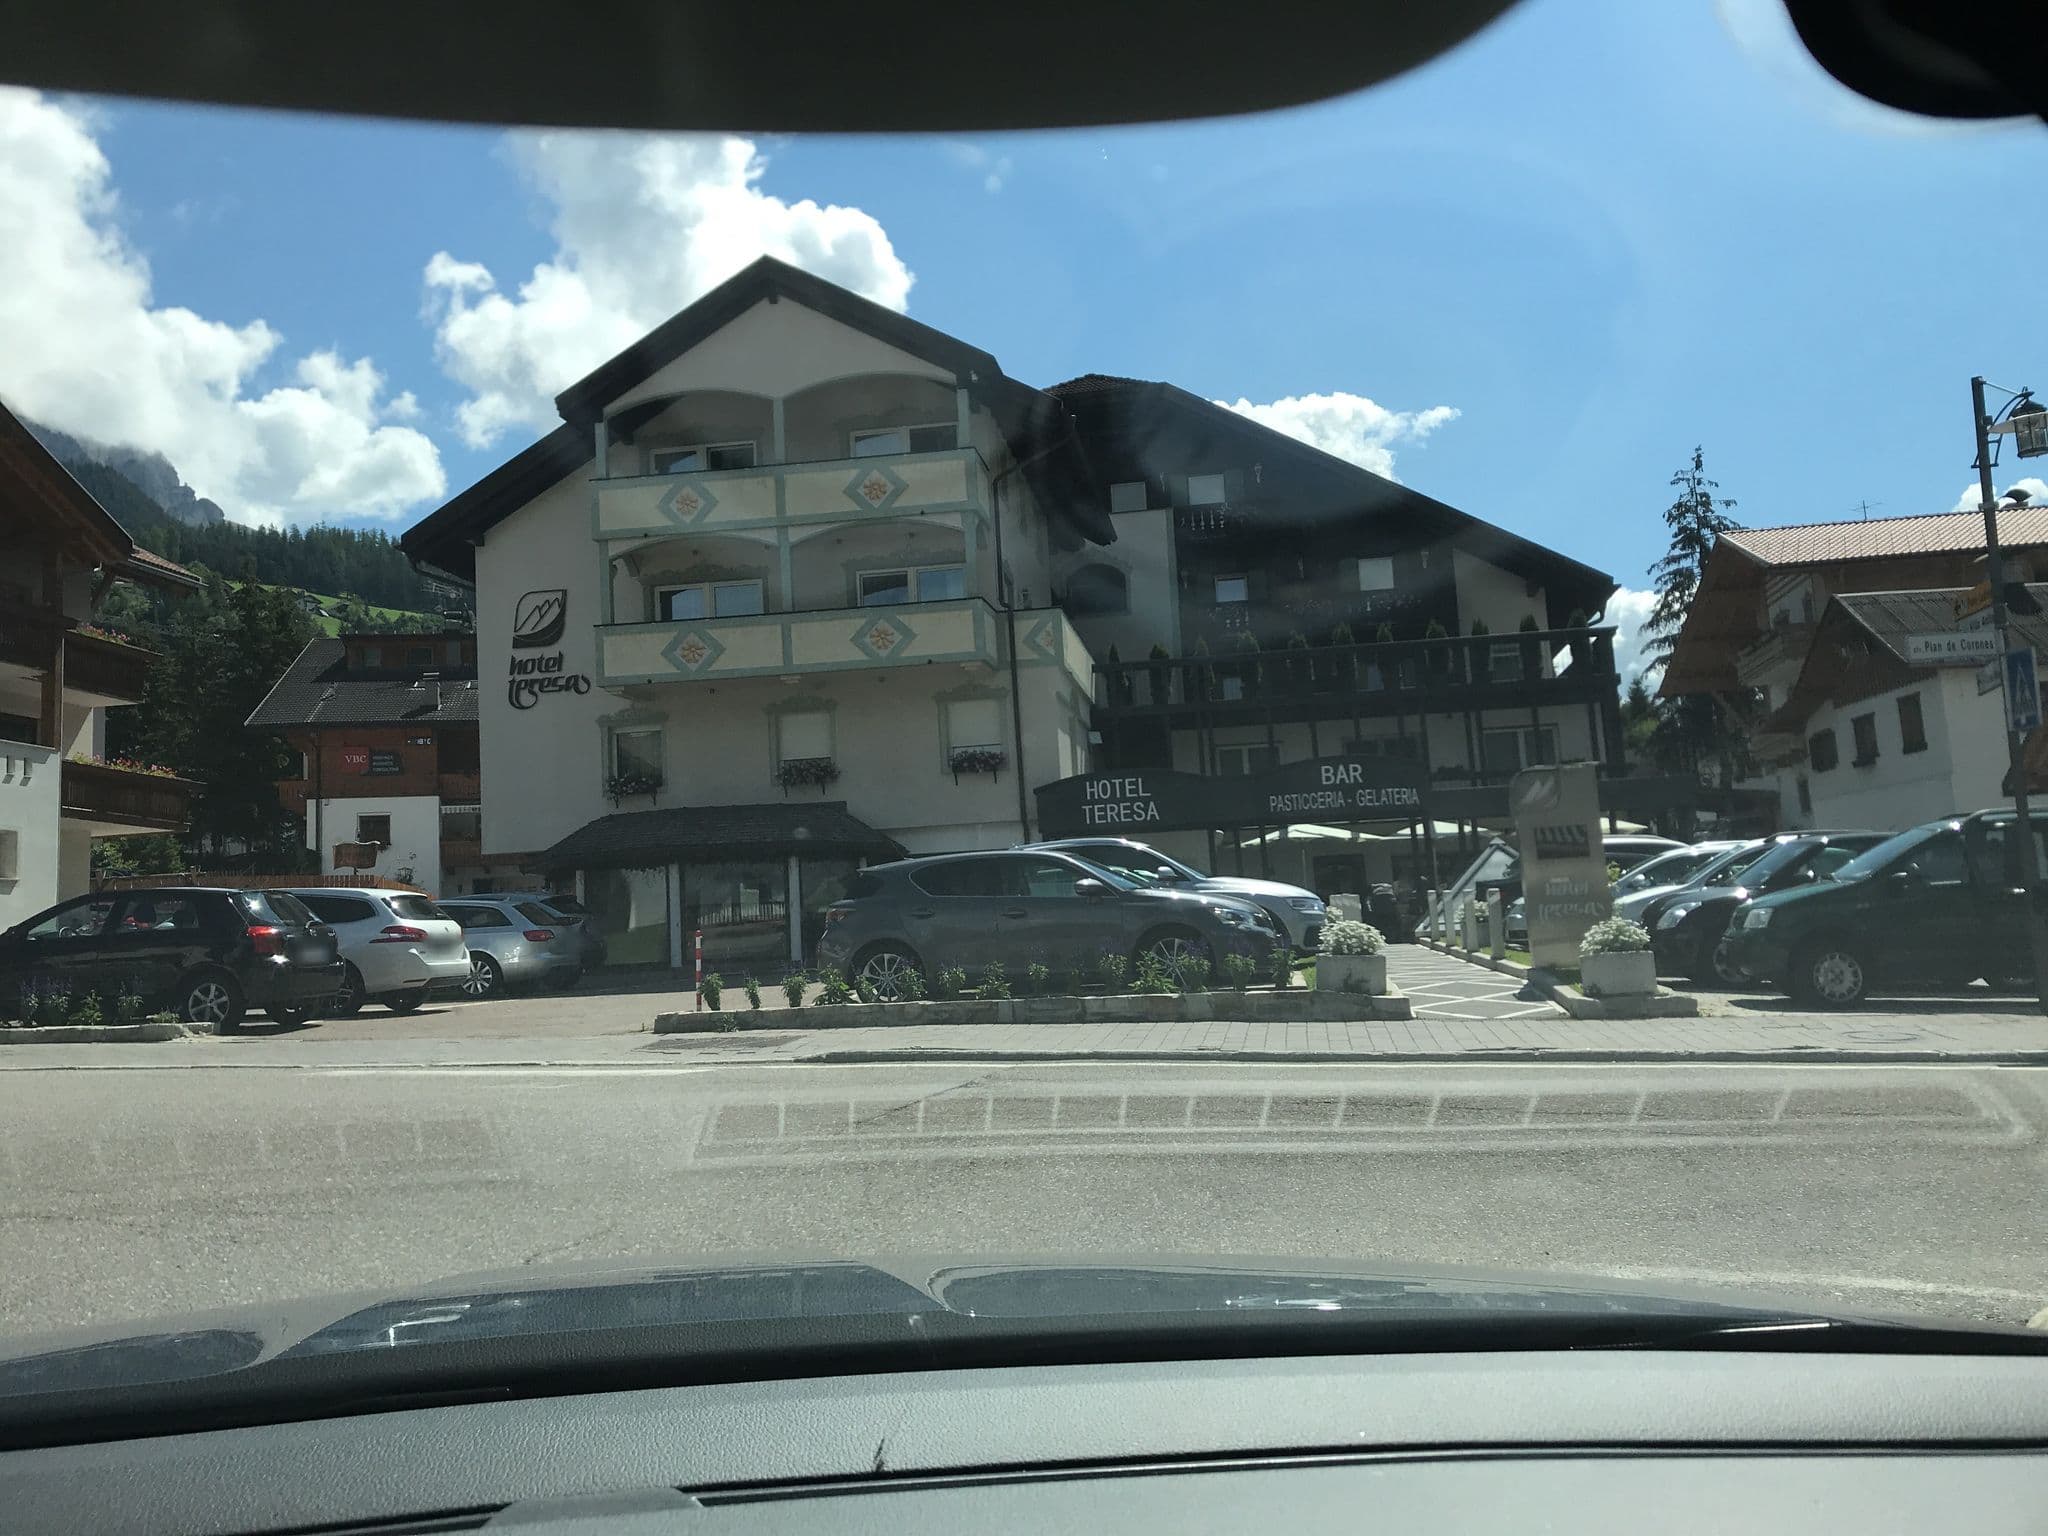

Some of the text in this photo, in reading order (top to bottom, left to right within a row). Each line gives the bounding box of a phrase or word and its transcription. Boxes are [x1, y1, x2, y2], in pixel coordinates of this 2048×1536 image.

[1924, 640, 1942, 652] Plan
[1946, 640, 1957, 652] de
[1960, 639, 1994, 650] Corones
[509, 651, 564, 676] hotel
[508, 673, 592, 710] teresa
[1320, 763, 1364, 785] BAR
[1085, 777, 1152, 800] HOTEL
[1269, 790, 1346, 813] PASTICCERIA
[1356, 787, 1421, 806] GELATERIA
[1081, 801, 1160, 825] TERESA
